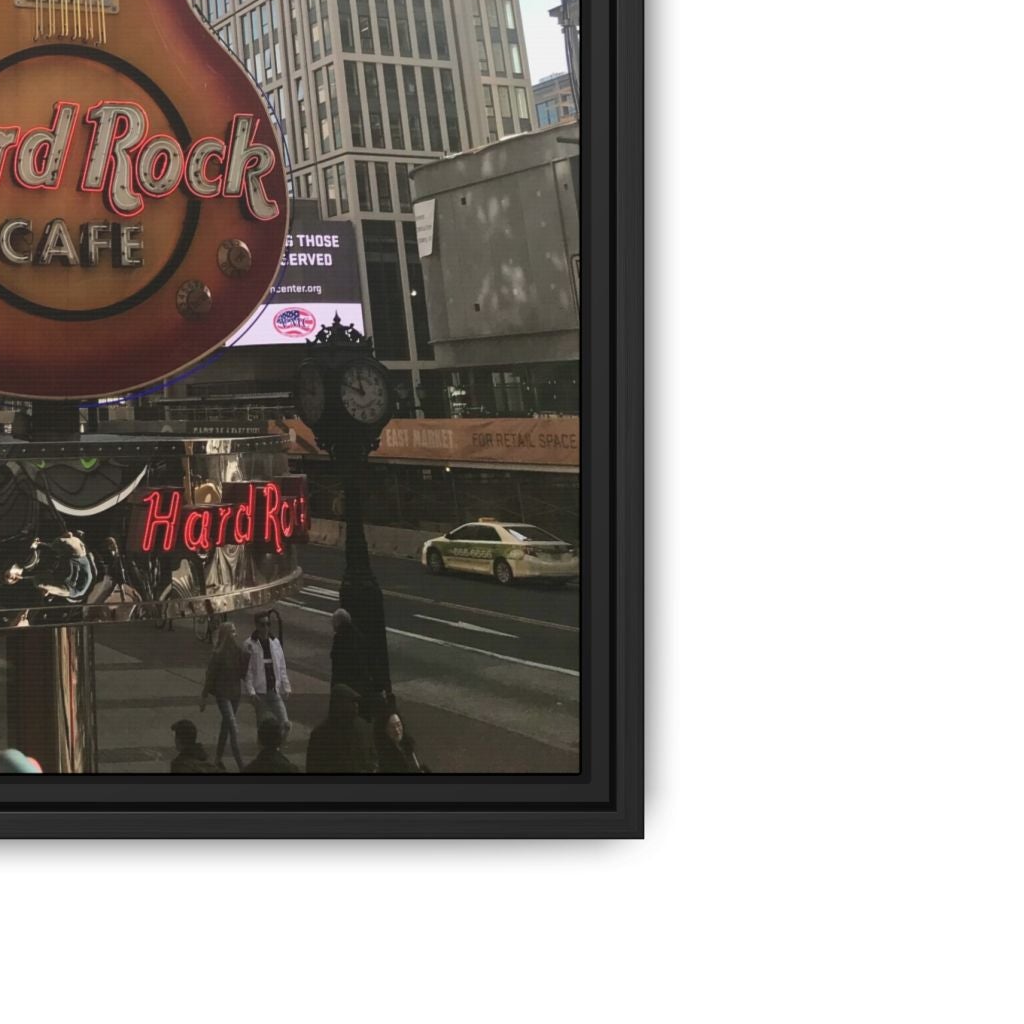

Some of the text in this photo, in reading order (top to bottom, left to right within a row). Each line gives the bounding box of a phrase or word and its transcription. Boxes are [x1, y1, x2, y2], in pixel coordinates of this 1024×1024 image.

[81, 99, 280, 220] Rock
[296, 234, 340, 248] THOSE
[384, 428, 409, 448] EAST
[471, 432, 578, 450] FOR RETAIL SPACE
[141, 481, 257, 554] Hard
